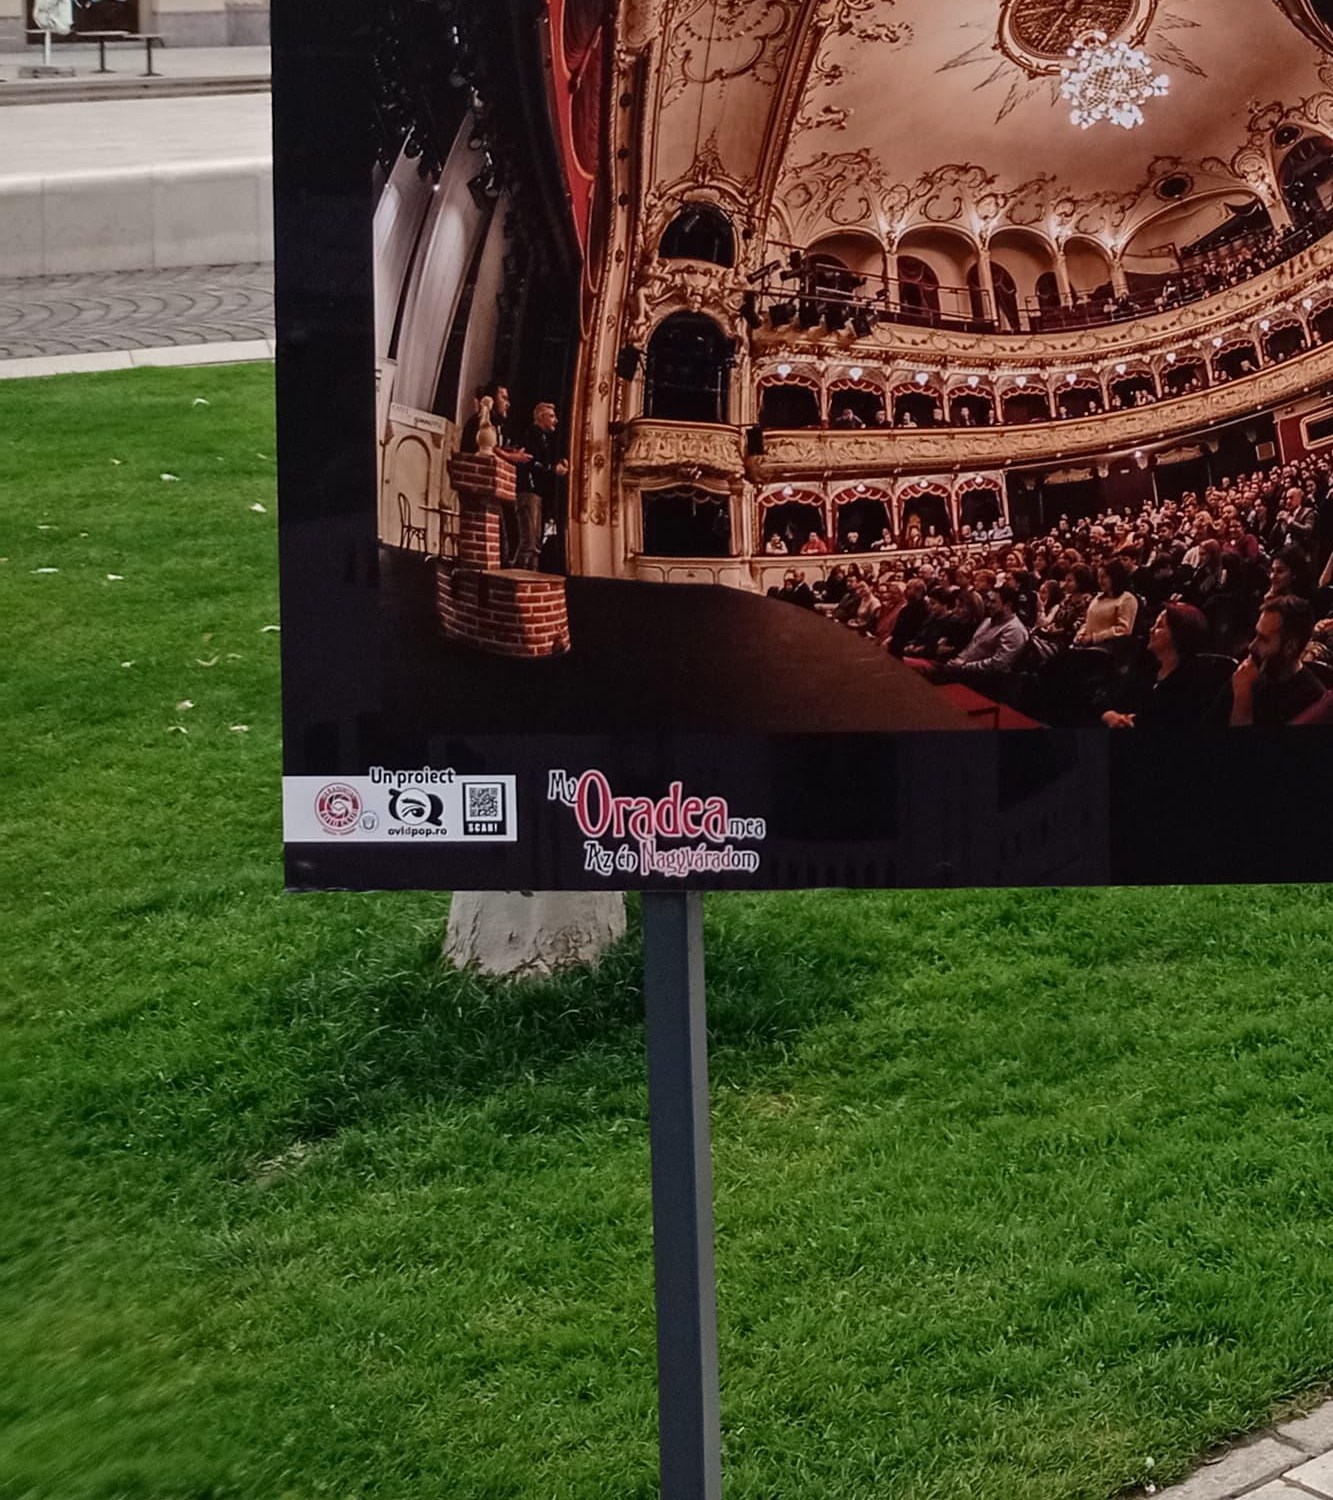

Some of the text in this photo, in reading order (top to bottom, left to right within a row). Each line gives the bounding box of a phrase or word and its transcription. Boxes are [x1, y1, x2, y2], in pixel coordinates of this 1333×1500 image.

[371, 766, 454, 788] Un proiect
[548, 770, 766, 842] My Oradea mea
[388, 826, 448, 837] ovidpop.ro
[584, 839, 760, 876] Az én Nagyváradom
